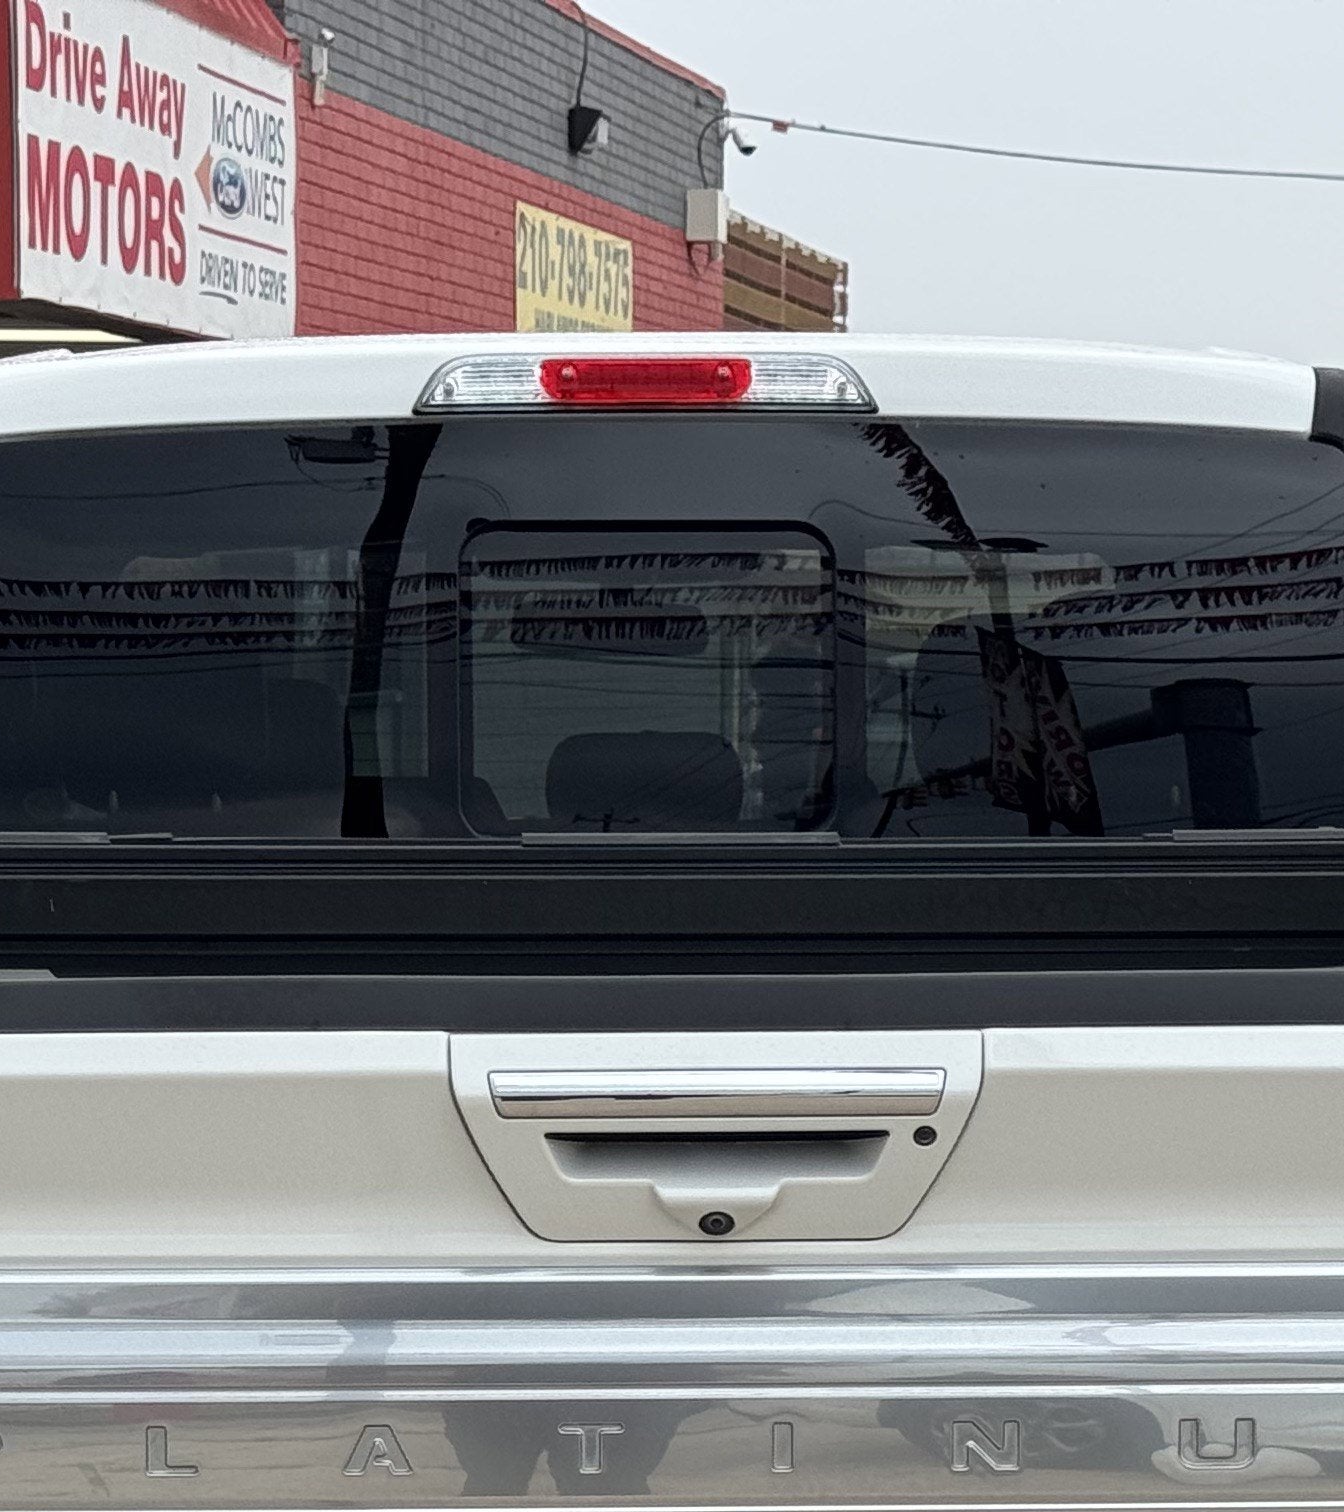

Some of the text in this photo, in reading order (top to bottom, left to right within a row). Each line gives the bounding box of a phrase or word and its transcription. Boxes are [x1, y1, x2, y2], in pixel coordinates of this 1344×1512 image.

[25, 0, 186, 161] Drive Away
[211, 91, 286, 169] McCOMBS
[26, 132, 187, 287] MOTORS
[245, 167, 287, 226] WEST
[199, 249, 287, 306] DRIVEN TO SERVE
